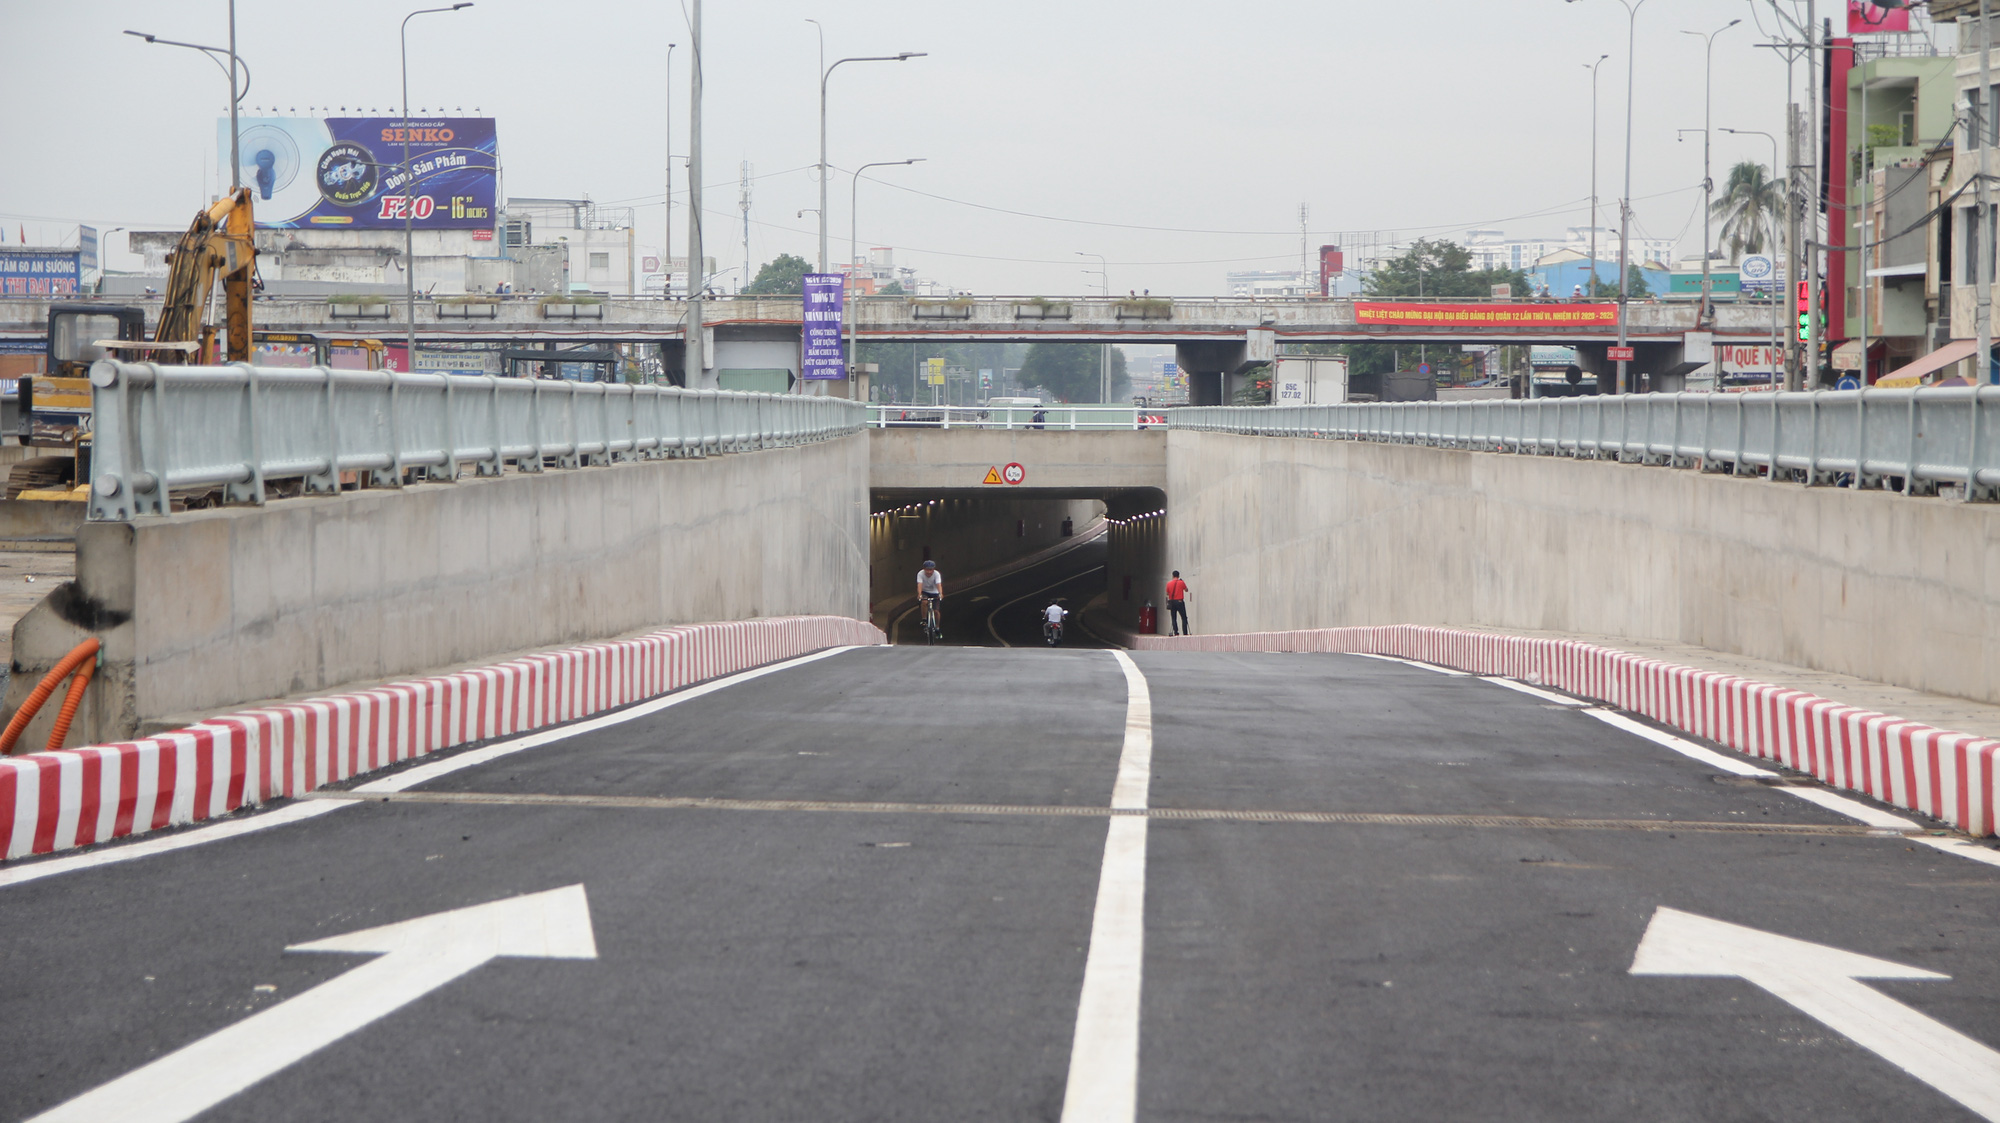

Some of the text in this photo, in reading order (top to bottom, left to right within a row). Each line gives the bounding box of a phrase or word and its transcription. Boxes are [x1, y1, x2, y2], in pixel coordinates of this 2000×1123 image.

[381, 128, 455, 142] SENKO
[412, 160, 434, 176] Sản
[434, 151, 467, 168] Phẩm
[378, 195, 434, 220] F20
[19, 261, 29, 272] 60
[31, 261, 43, 272] AN
[1512, 312, 1519, 320] 12
[1581, 312, 1595, 320] 2020
[1600, 311, 1614, 319] 2025
[387, 357, 397, 368] Bé
[1281, 391, 1301, 399] 127.02
